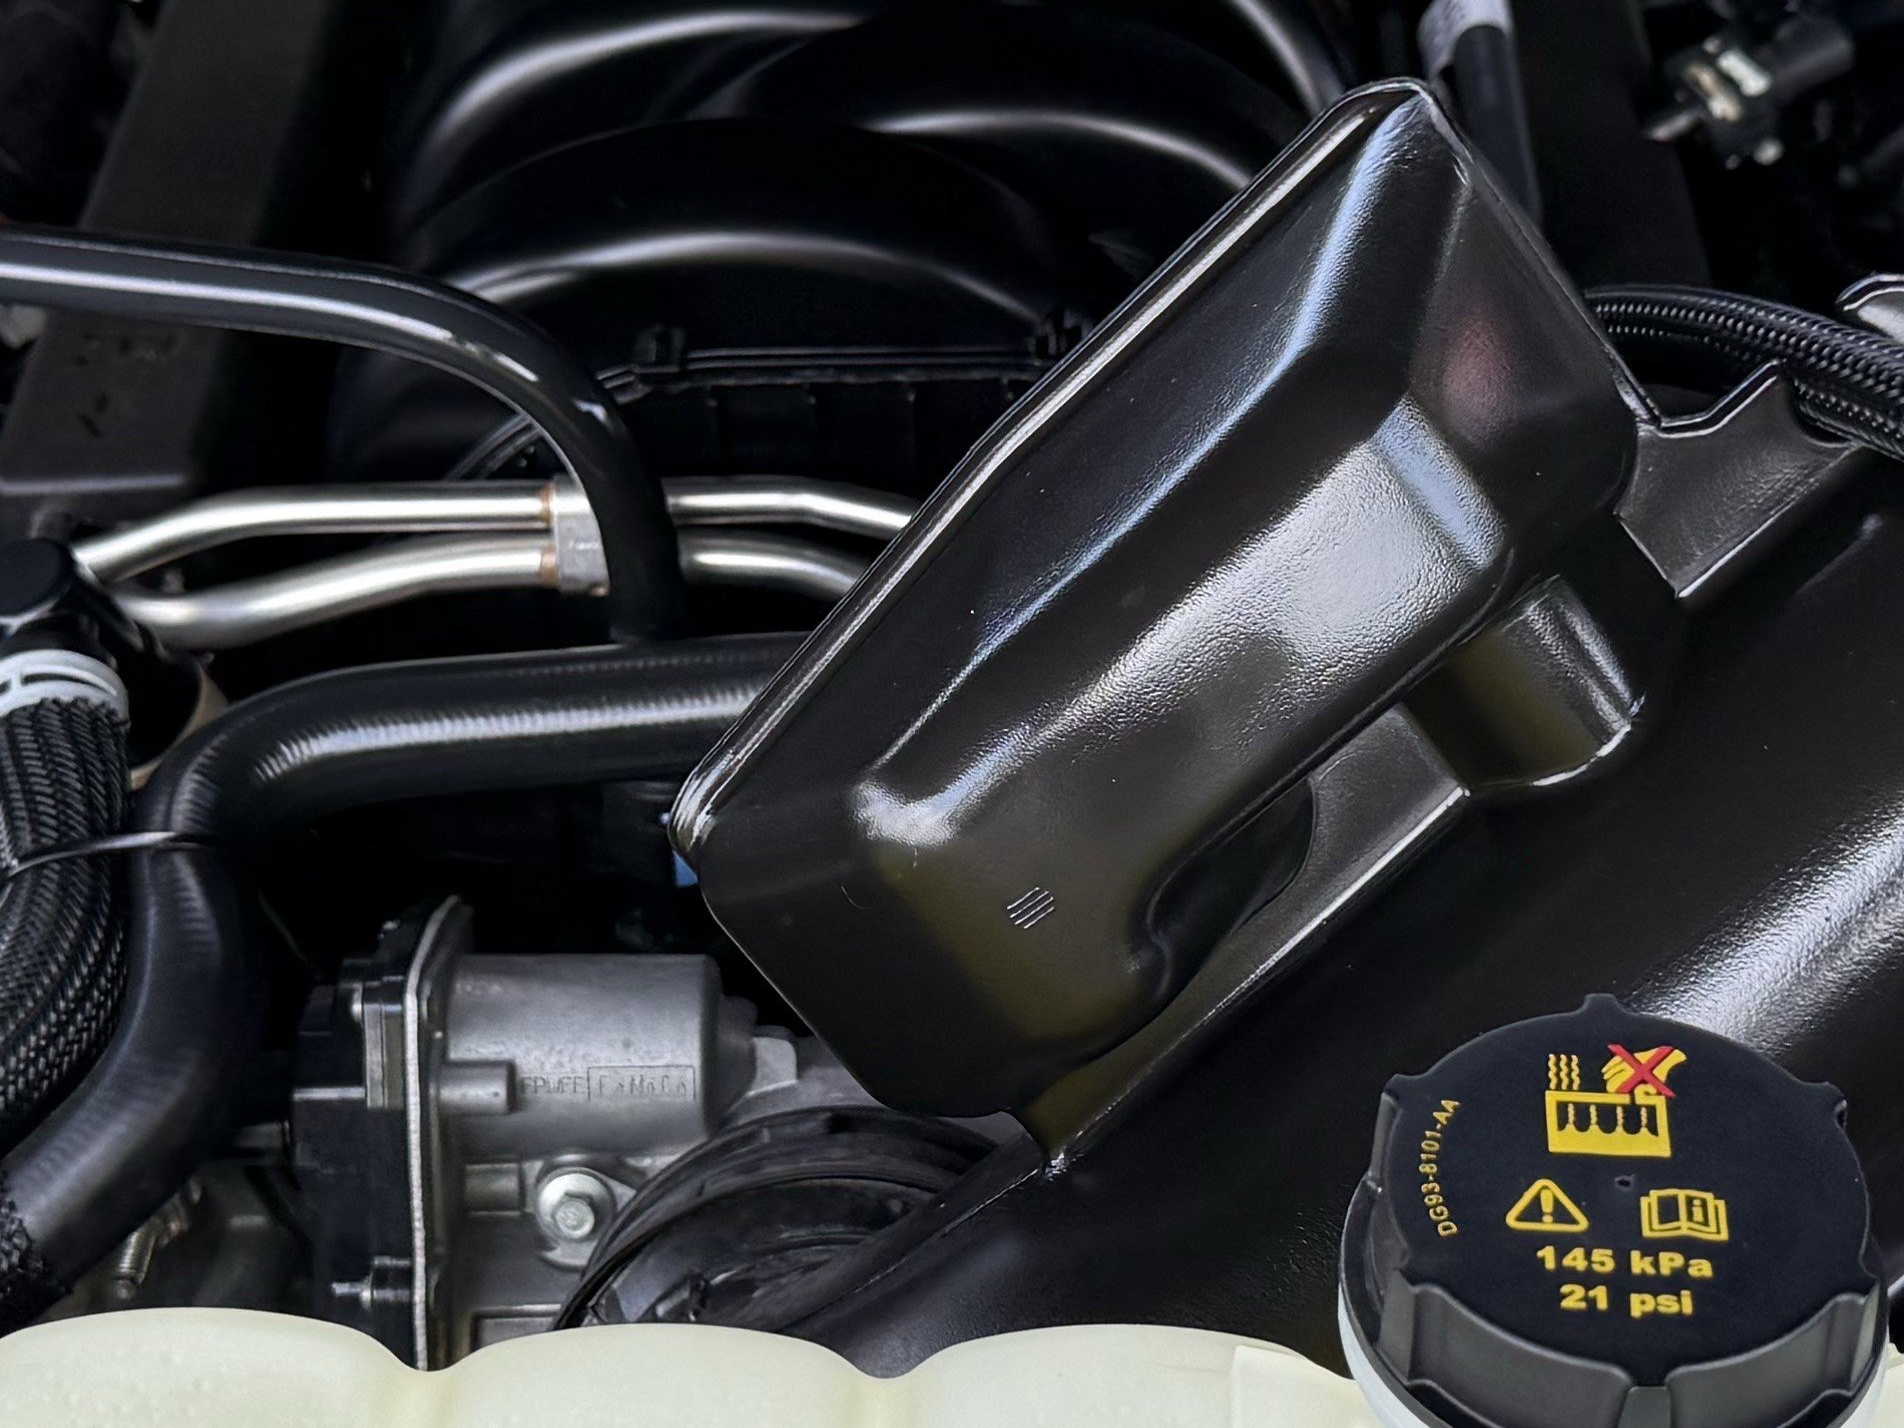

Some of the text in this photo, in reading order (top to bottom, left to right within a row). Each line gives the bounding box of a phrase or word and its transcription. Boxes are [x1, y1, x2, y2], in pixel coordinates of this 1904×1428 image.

[1418, 1099, 1461, 1238] DG93-8101-AA
[1536, 1245, 1713, 1278] 145 kPa
[1559, 1283, 1693, 1319] 21 psi
